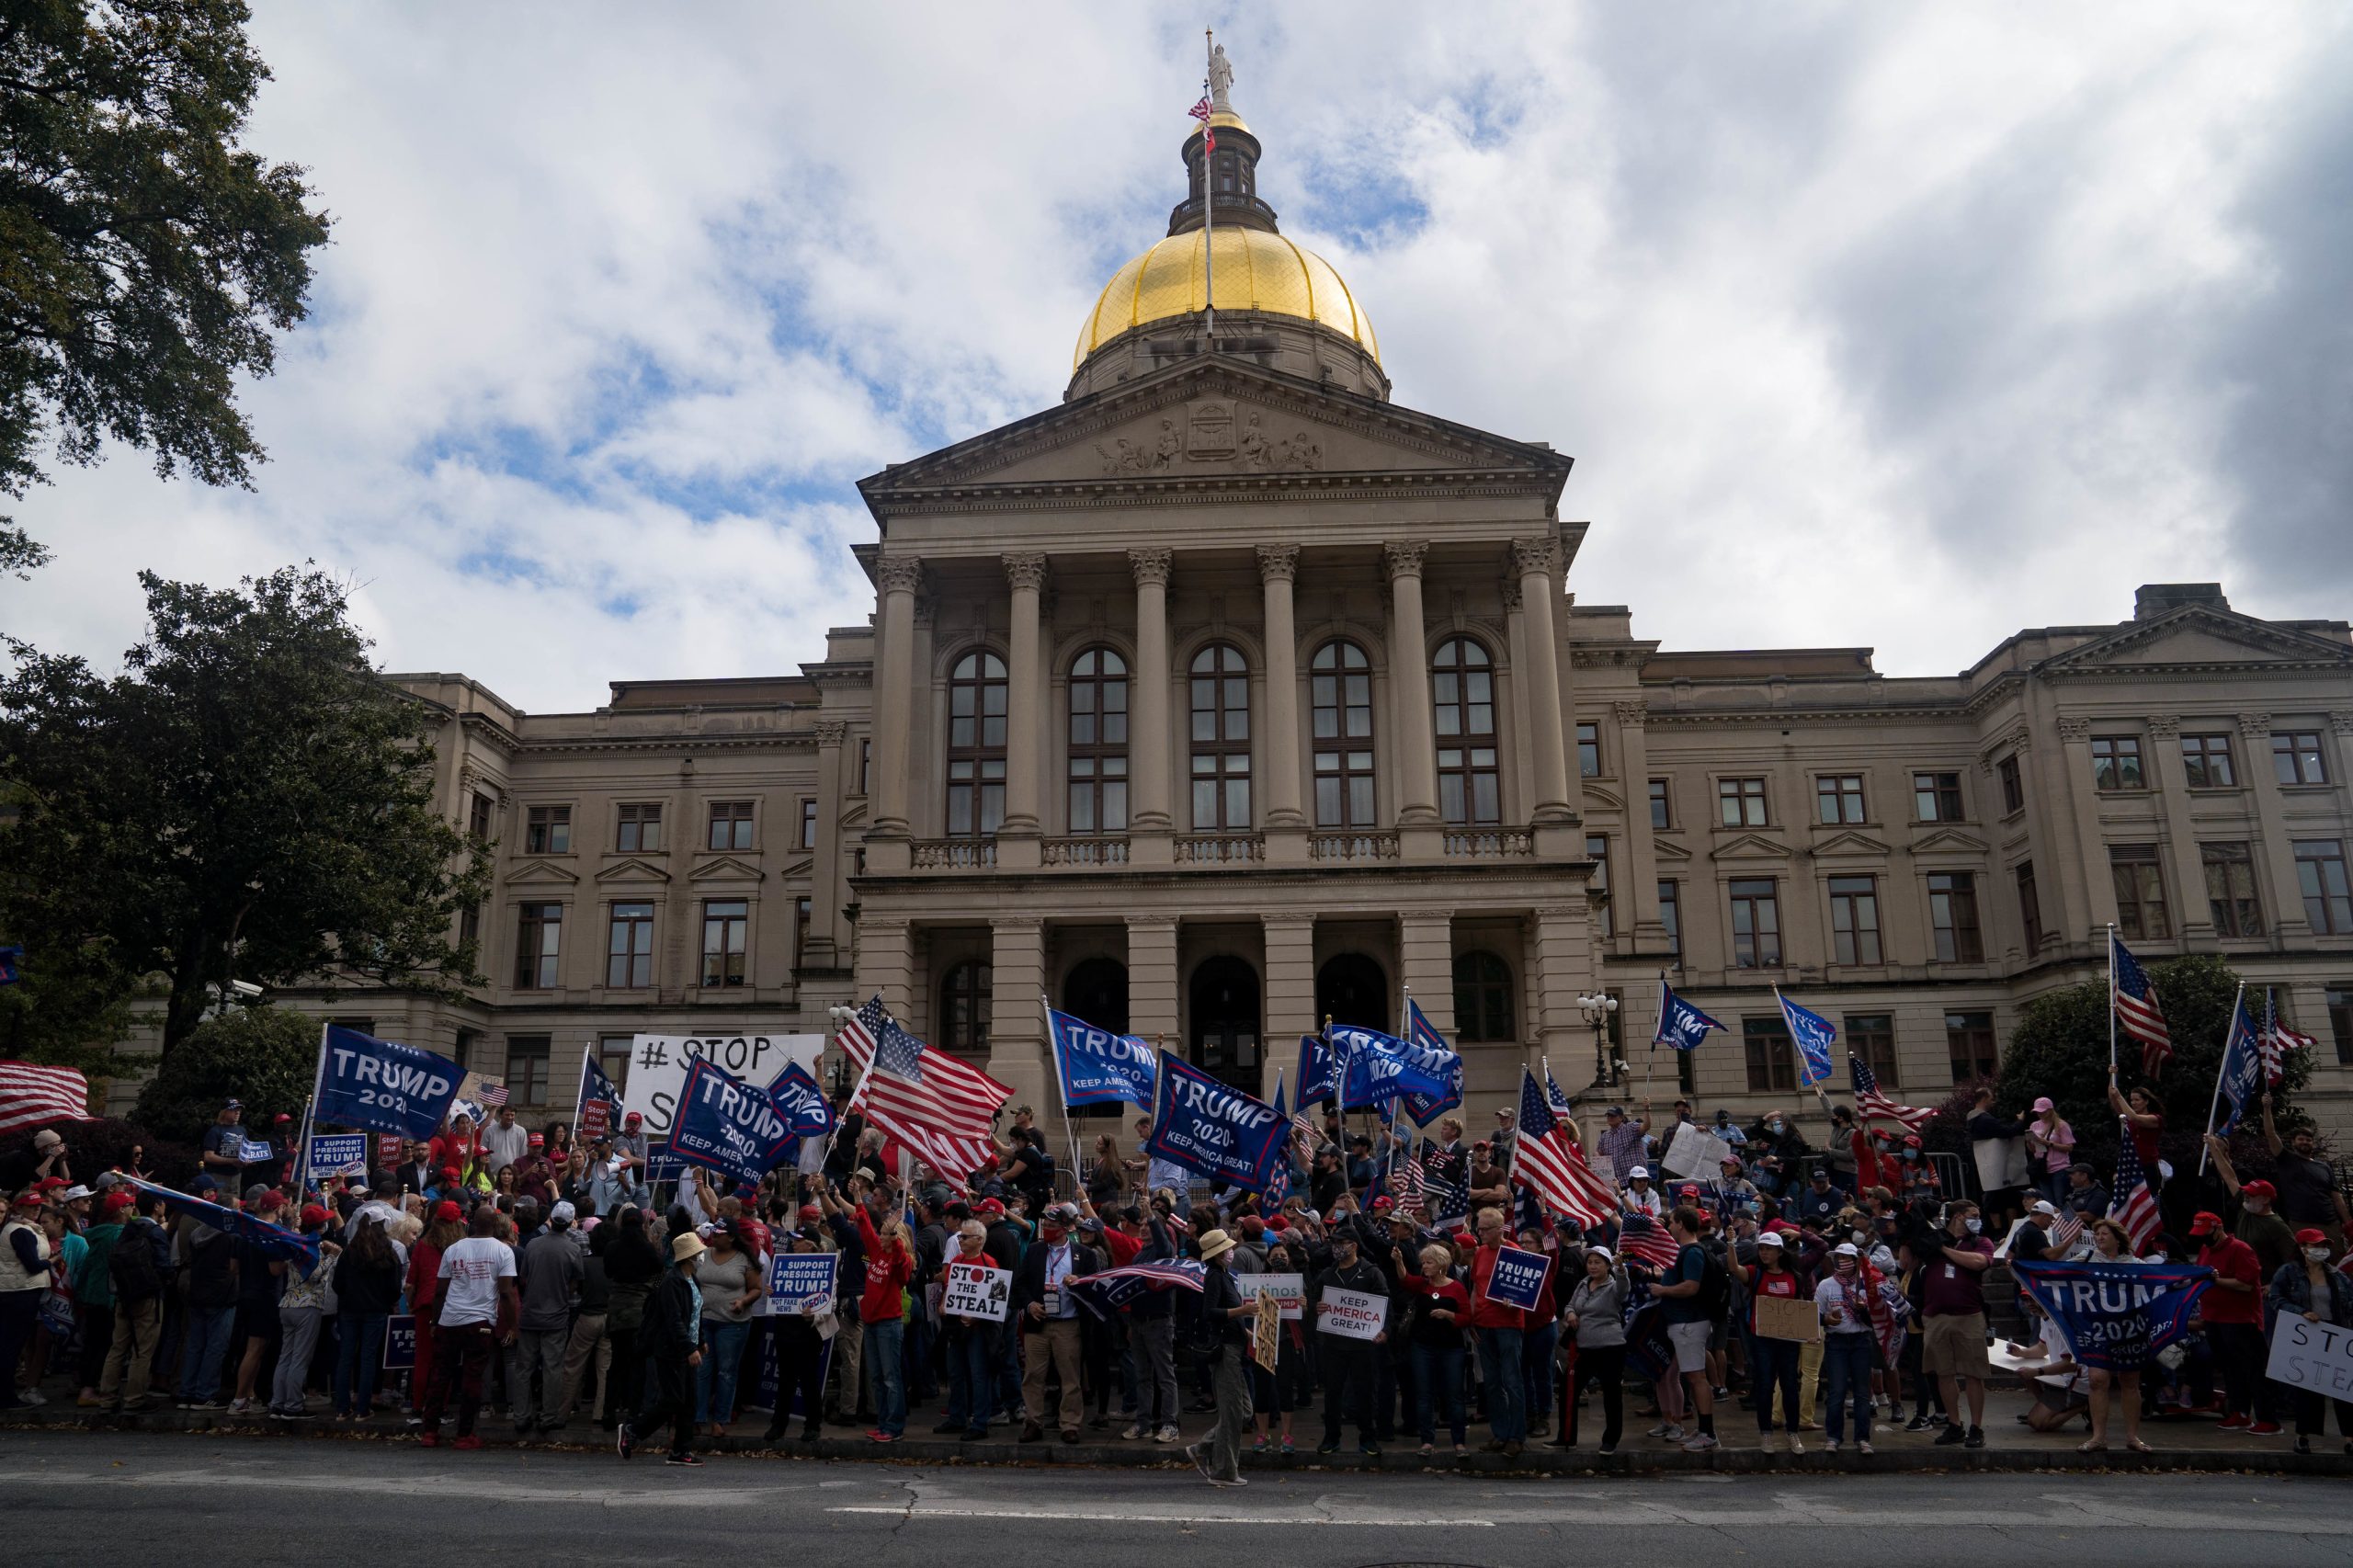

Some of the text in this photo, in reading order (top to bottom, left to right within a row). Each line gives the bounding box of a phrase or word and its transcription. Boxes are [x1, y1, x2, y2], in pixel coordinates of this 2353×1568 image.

[676, 1037, 771, 1072] STOP
[334, 1048, 450, 1101] TRUMP
[1073, 1078, 1101, 1088] KEEP
[702, 1073, 785, 1141] TRUMP
[1171, 1074, 1279, 1129] TRUMP
[587, 1106, 607, 1115] Stop
[588, 1115, 603, 1123] the
[585, 1123, 605, 1132] Steal
[381, 1136, 400, 1144] Stop
[681, 1132, 712, 1150] KEEP
[314, 1153, 362, 1164] TRUMP
[1166, 1131, 1192, 1147] KEEP
[1224, 1156, 1254, 1174] GREAT!
[788, 1261, 831, 1269] SUPPORT
[1497, 1260, 1542, 1280] TRUMP
[777, 1270, 830, 1278] PRESIDENT
[1497, 1273, 1535, 1289] PENCE
[774, 1279, 829, 1292] TRUMP
[957, 1282, 977, 1294] THE
[1243, 1283, 1298, 1298] Lainos
[801, 1294, 827, 1310] MEDIA
[946, 1294, 999, 1315] STEAL
[1340, 1296, 1368, 1308] KEEP
[1764, 1298, 1809, 1316] STOP
[1325, 1304, 1381, 1323] AMERICA
[1331, 1317, 1371, 1333] GREAT!
